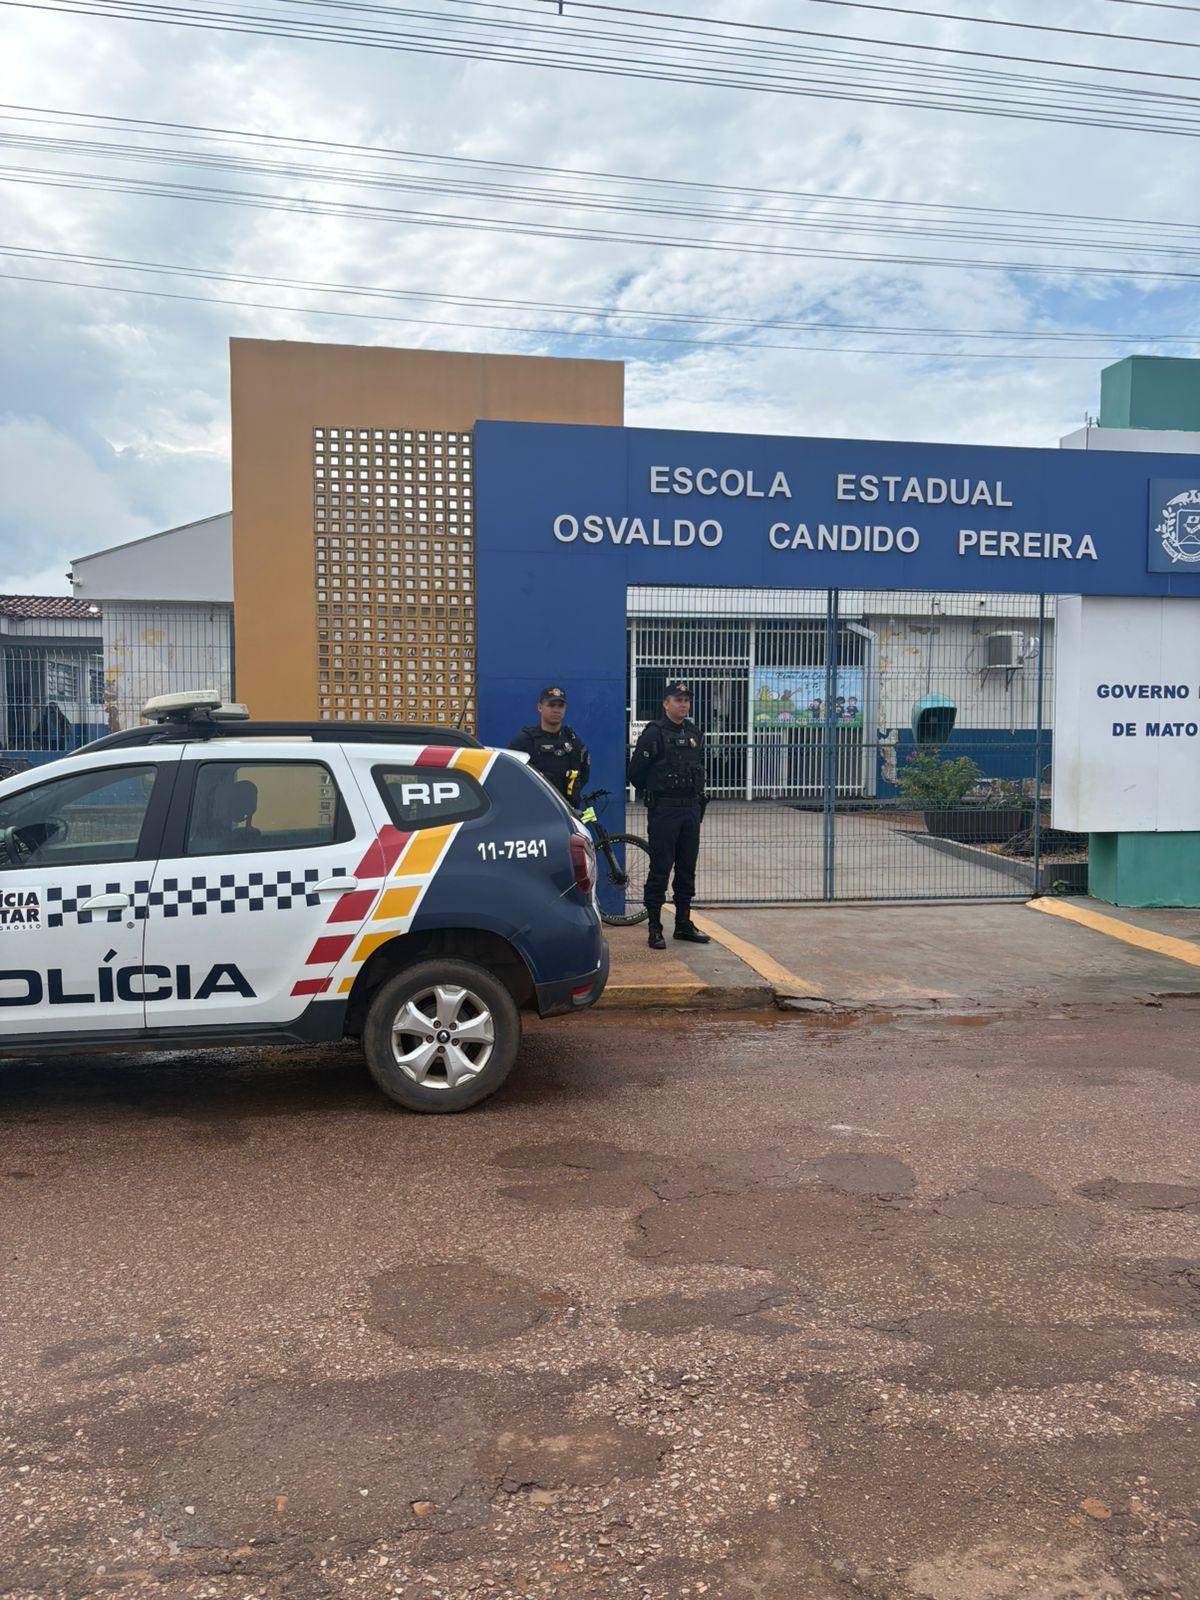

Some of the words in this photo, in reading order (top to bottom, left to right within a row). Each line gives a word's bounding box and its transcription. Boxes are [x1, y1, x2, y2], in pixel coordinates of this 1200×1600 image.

[650, 466, 792, 498] ESCOLA
[837, 474, 1013, 507] ESTADUAL
[553, 514, 723, 547] OSVALDO
[769, 522, 920, 554] CANDIDO
[958, 529, 1098, 560] PEREIRA
[1097, 684, 1190, 699] GOVERNO
[1112, 722, 1137, 737] DE
[1146, 722, 1198, 737] MATO
[401, 782, 460, 806] RP
[477, 839, 547, 860] 11-7241
